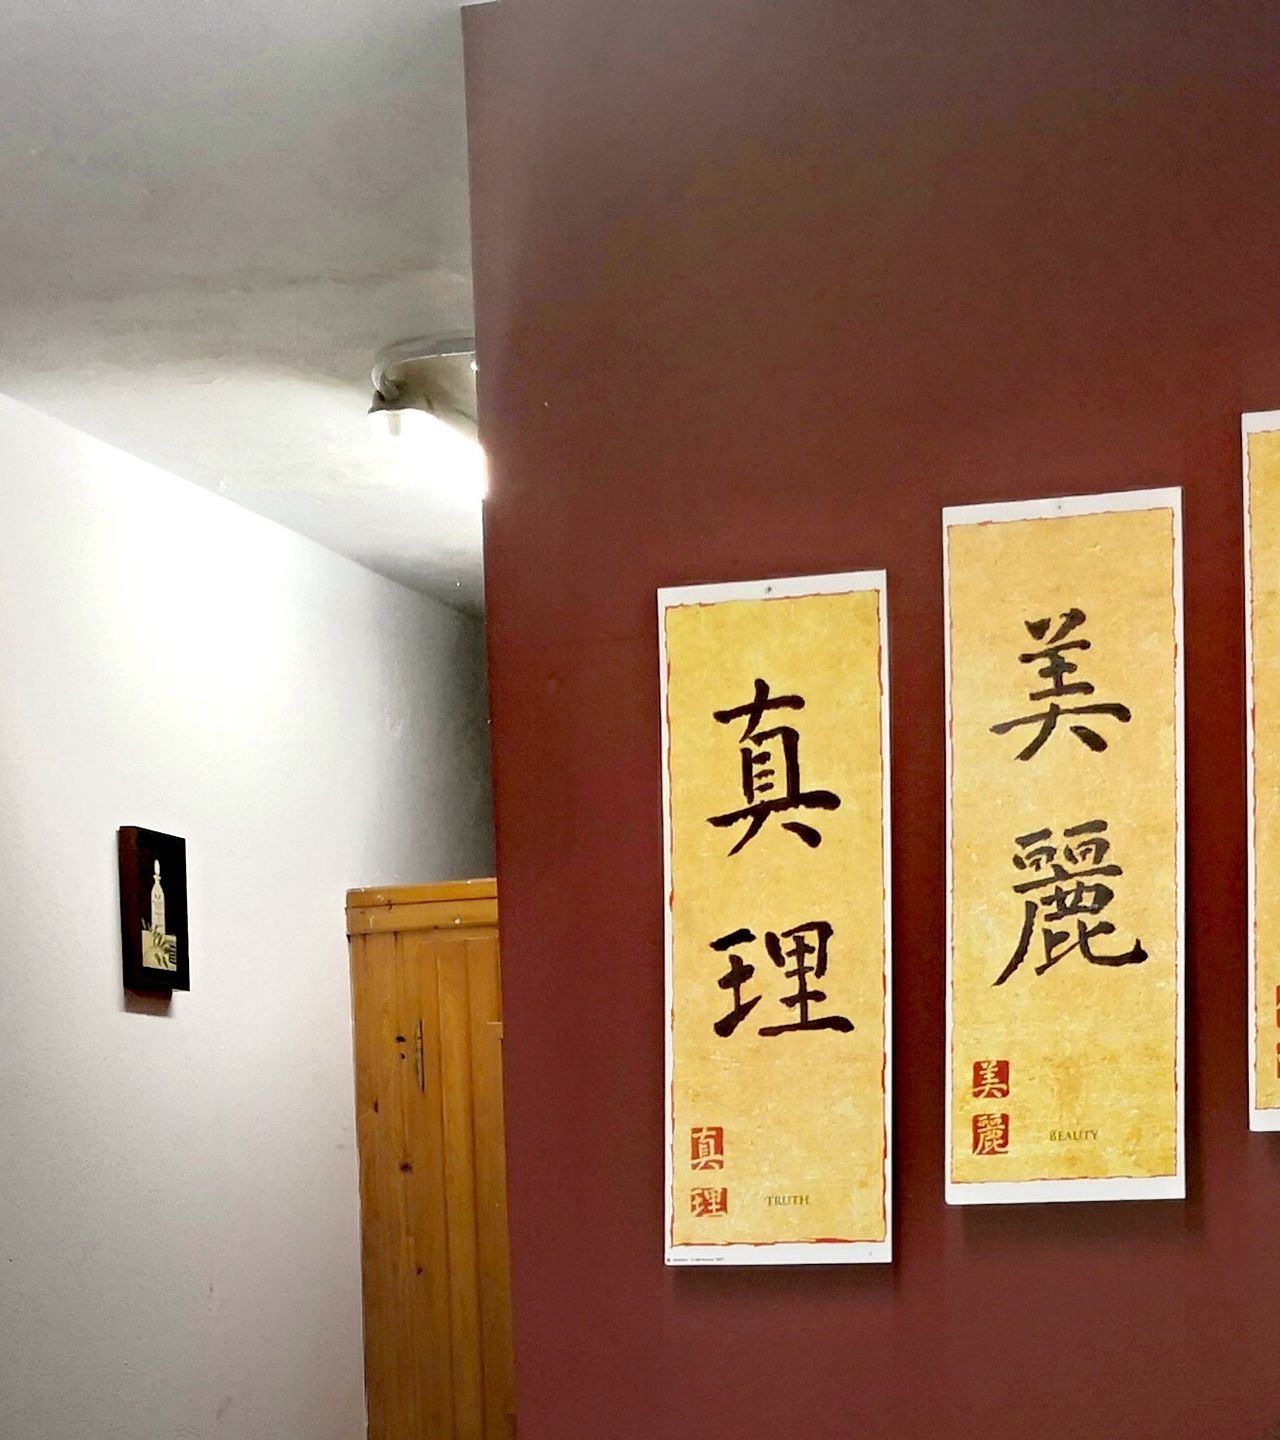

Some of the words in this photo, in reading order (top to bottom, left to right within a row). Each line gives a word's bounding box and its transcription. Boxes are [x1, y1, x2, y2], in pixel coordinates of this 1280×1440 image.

[989, 607, 1149, 987] 美麗
[707, 678, 855, 1038] 真理
[972, 1060, 1010, 1156] 美麗
[1048, 1129, 1099, 1142] BEAUTY
[765, 1194, 810, 1207] TRUTH
